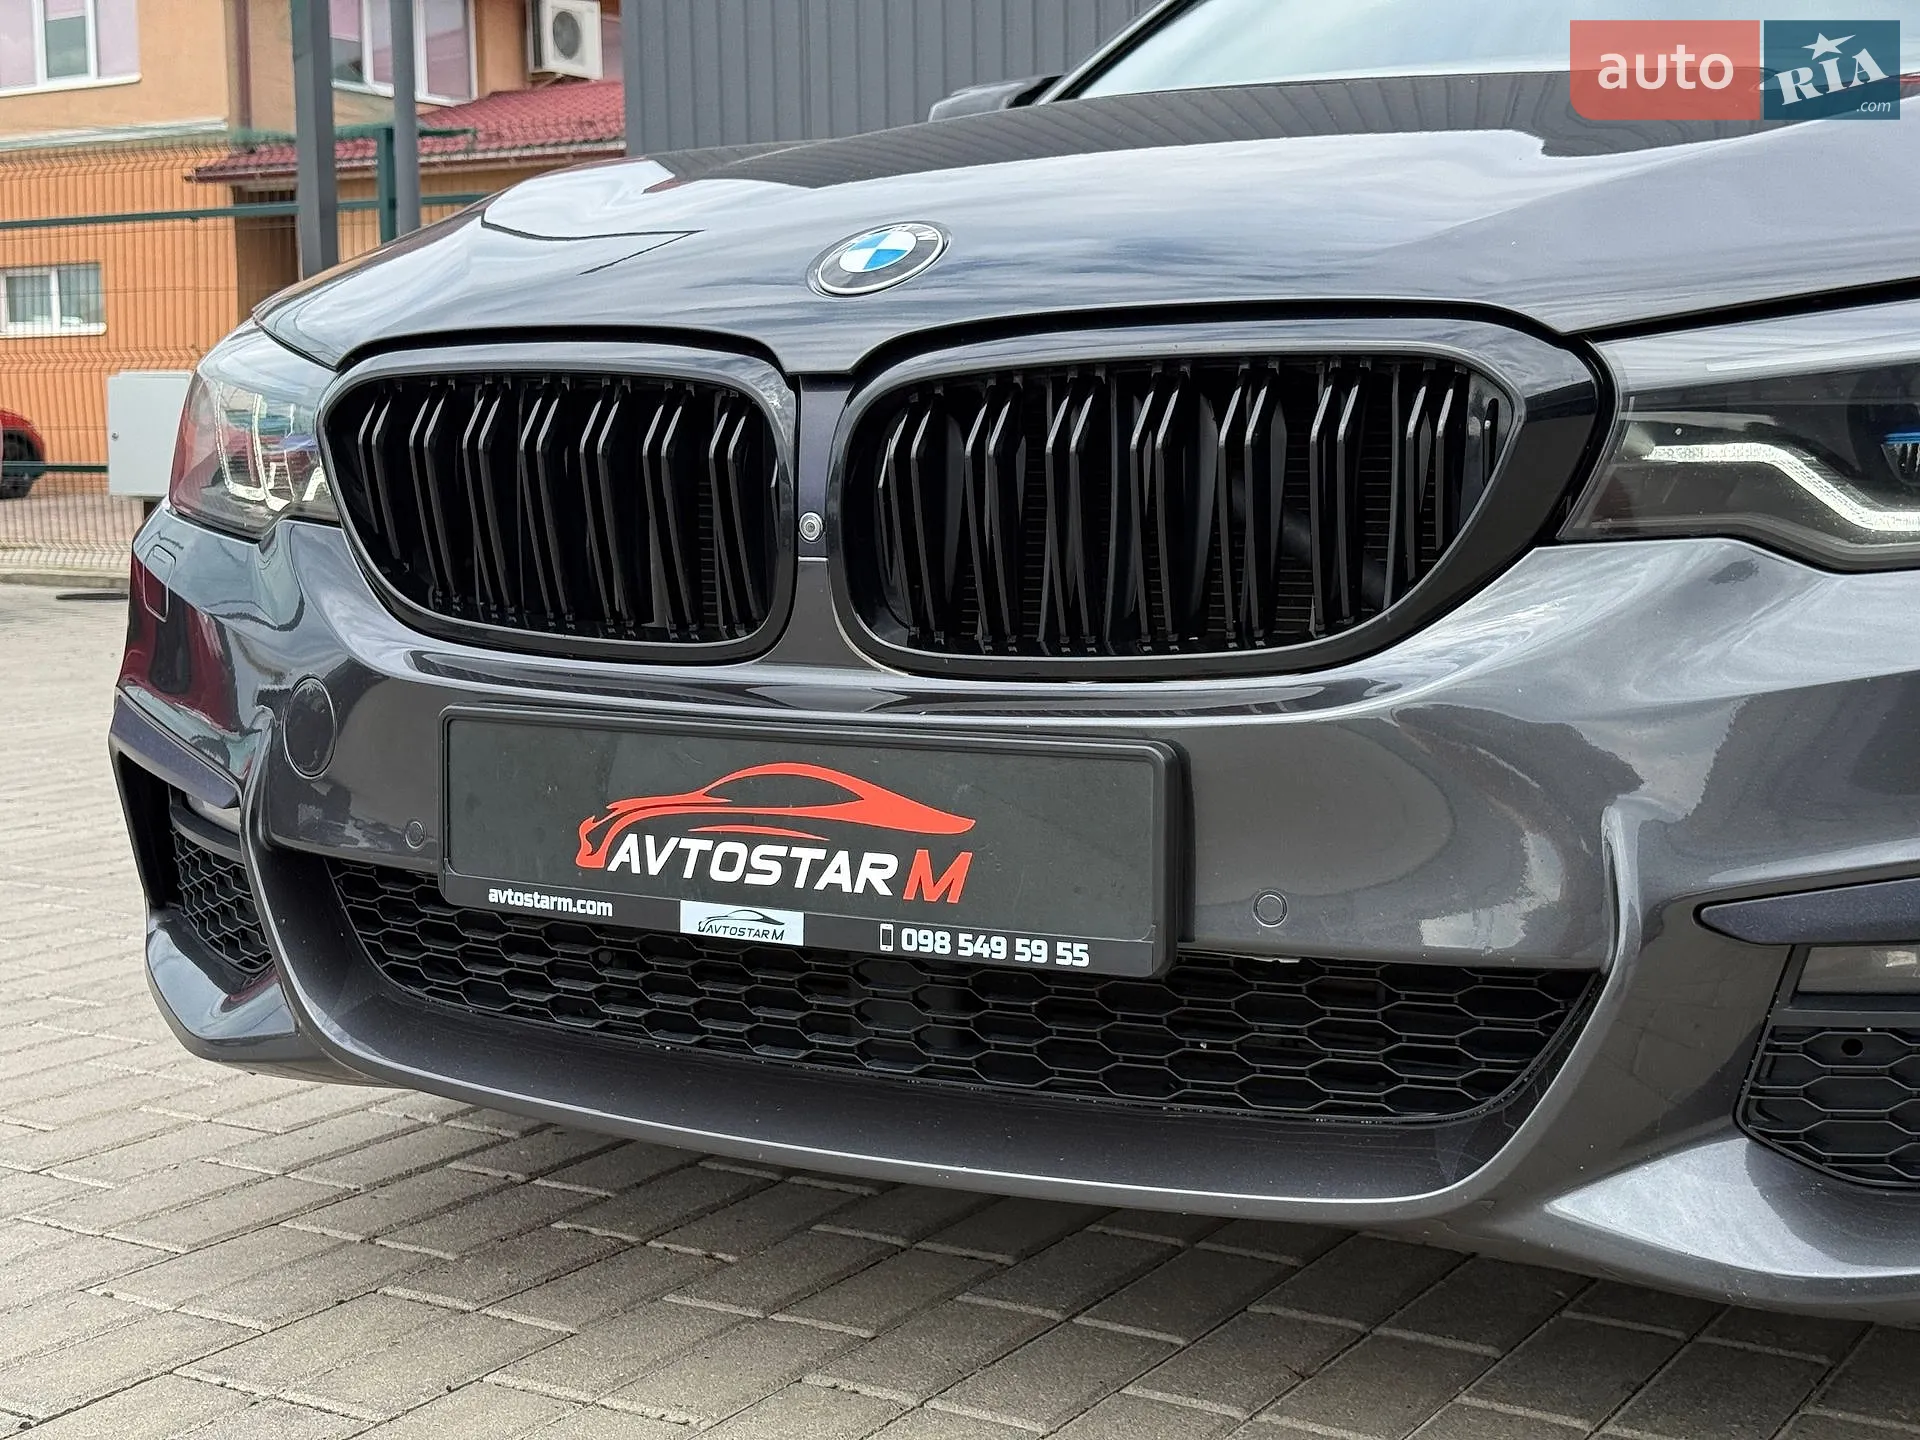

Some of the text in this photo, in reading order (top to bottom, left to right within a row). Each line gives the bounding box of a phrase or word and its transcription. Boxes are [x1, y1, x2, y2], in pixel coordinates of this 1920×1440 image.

[607, 833, 972, 904] AVTOSTAR M
[488, 888, 613, 917] avtostarm.com
[705, 924, 785, 941] AVTOSTAR M
[901, 928, 1090, 967] 098 549 59 55
